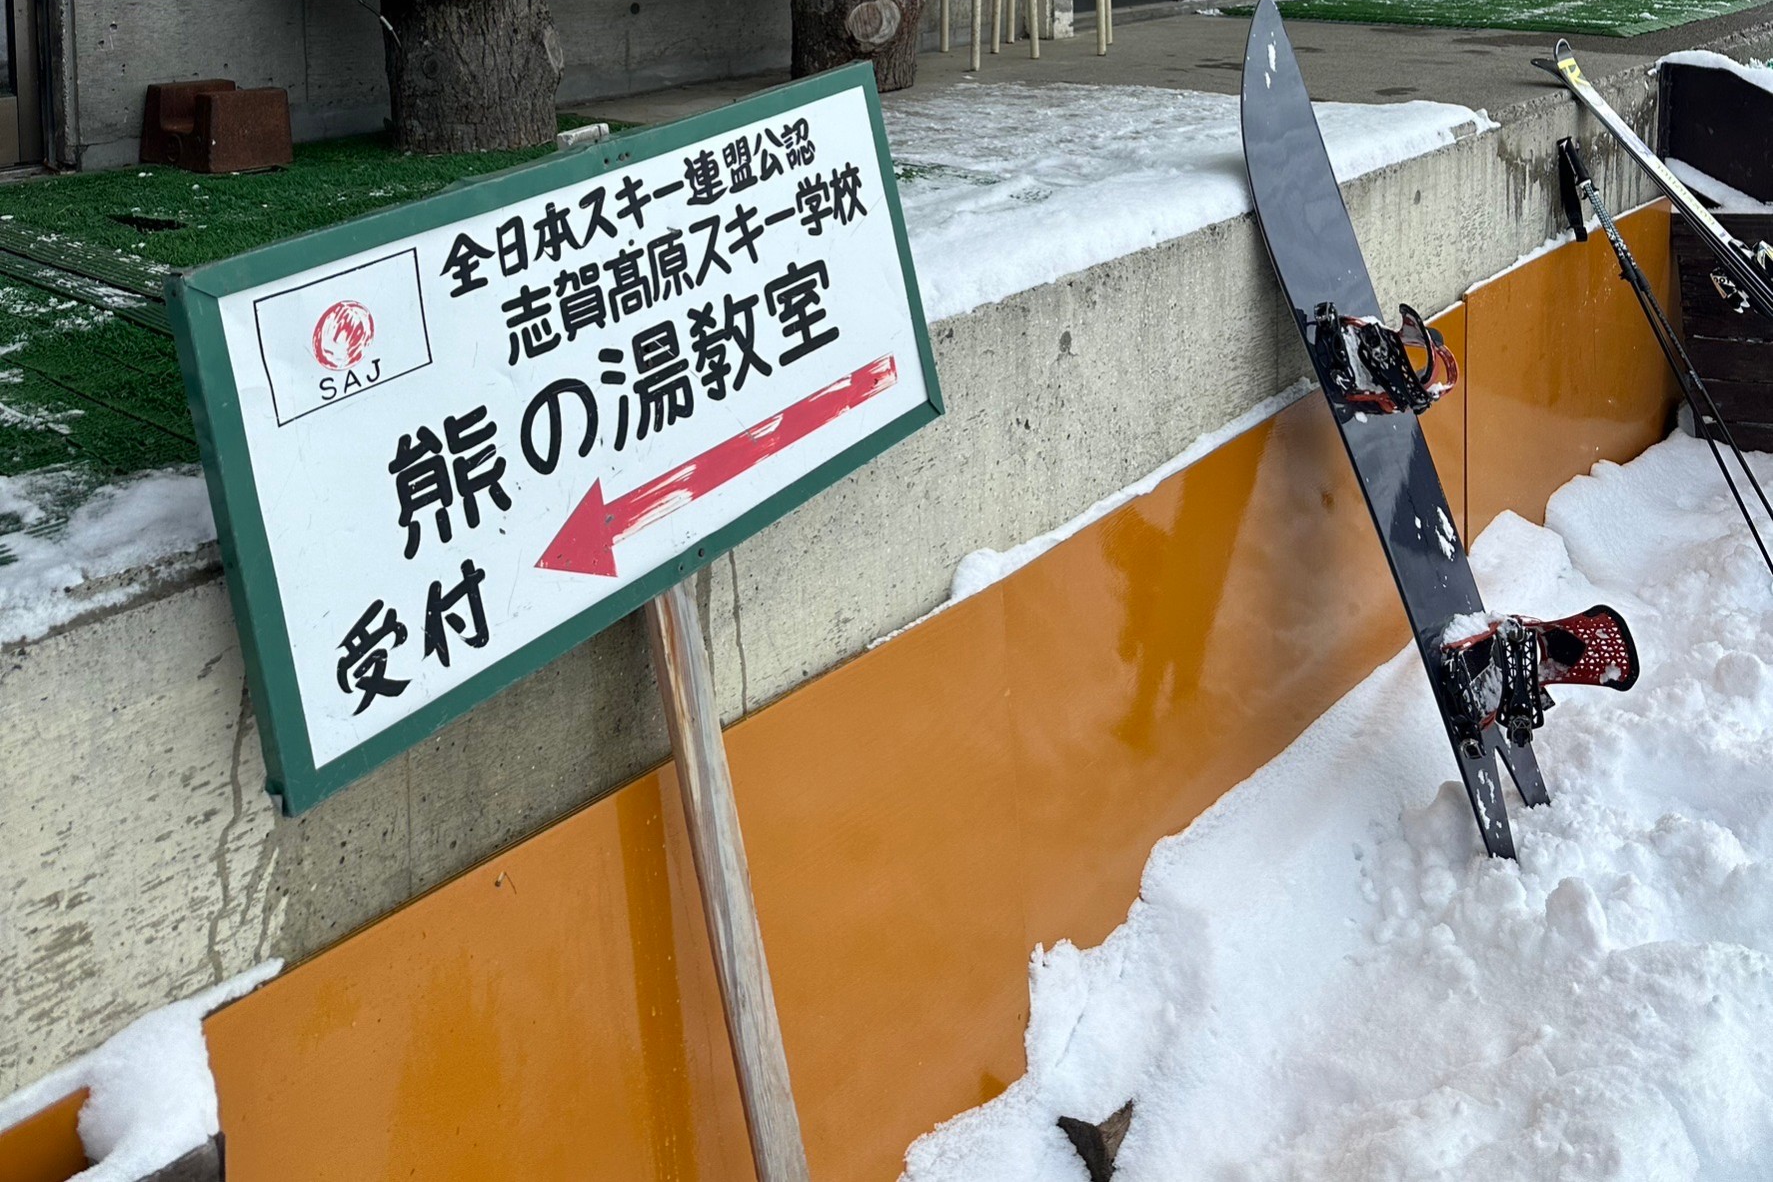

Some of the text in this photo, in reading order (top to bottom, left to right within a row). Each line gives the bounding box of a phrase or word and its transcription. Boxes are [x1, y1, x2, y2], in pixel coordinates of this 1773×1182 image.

[439, 117, 816, 297] 全日本スキー連盟公認
[319, 358, 381, 401] SAJ
[336, 558, 489, 716] 受付
